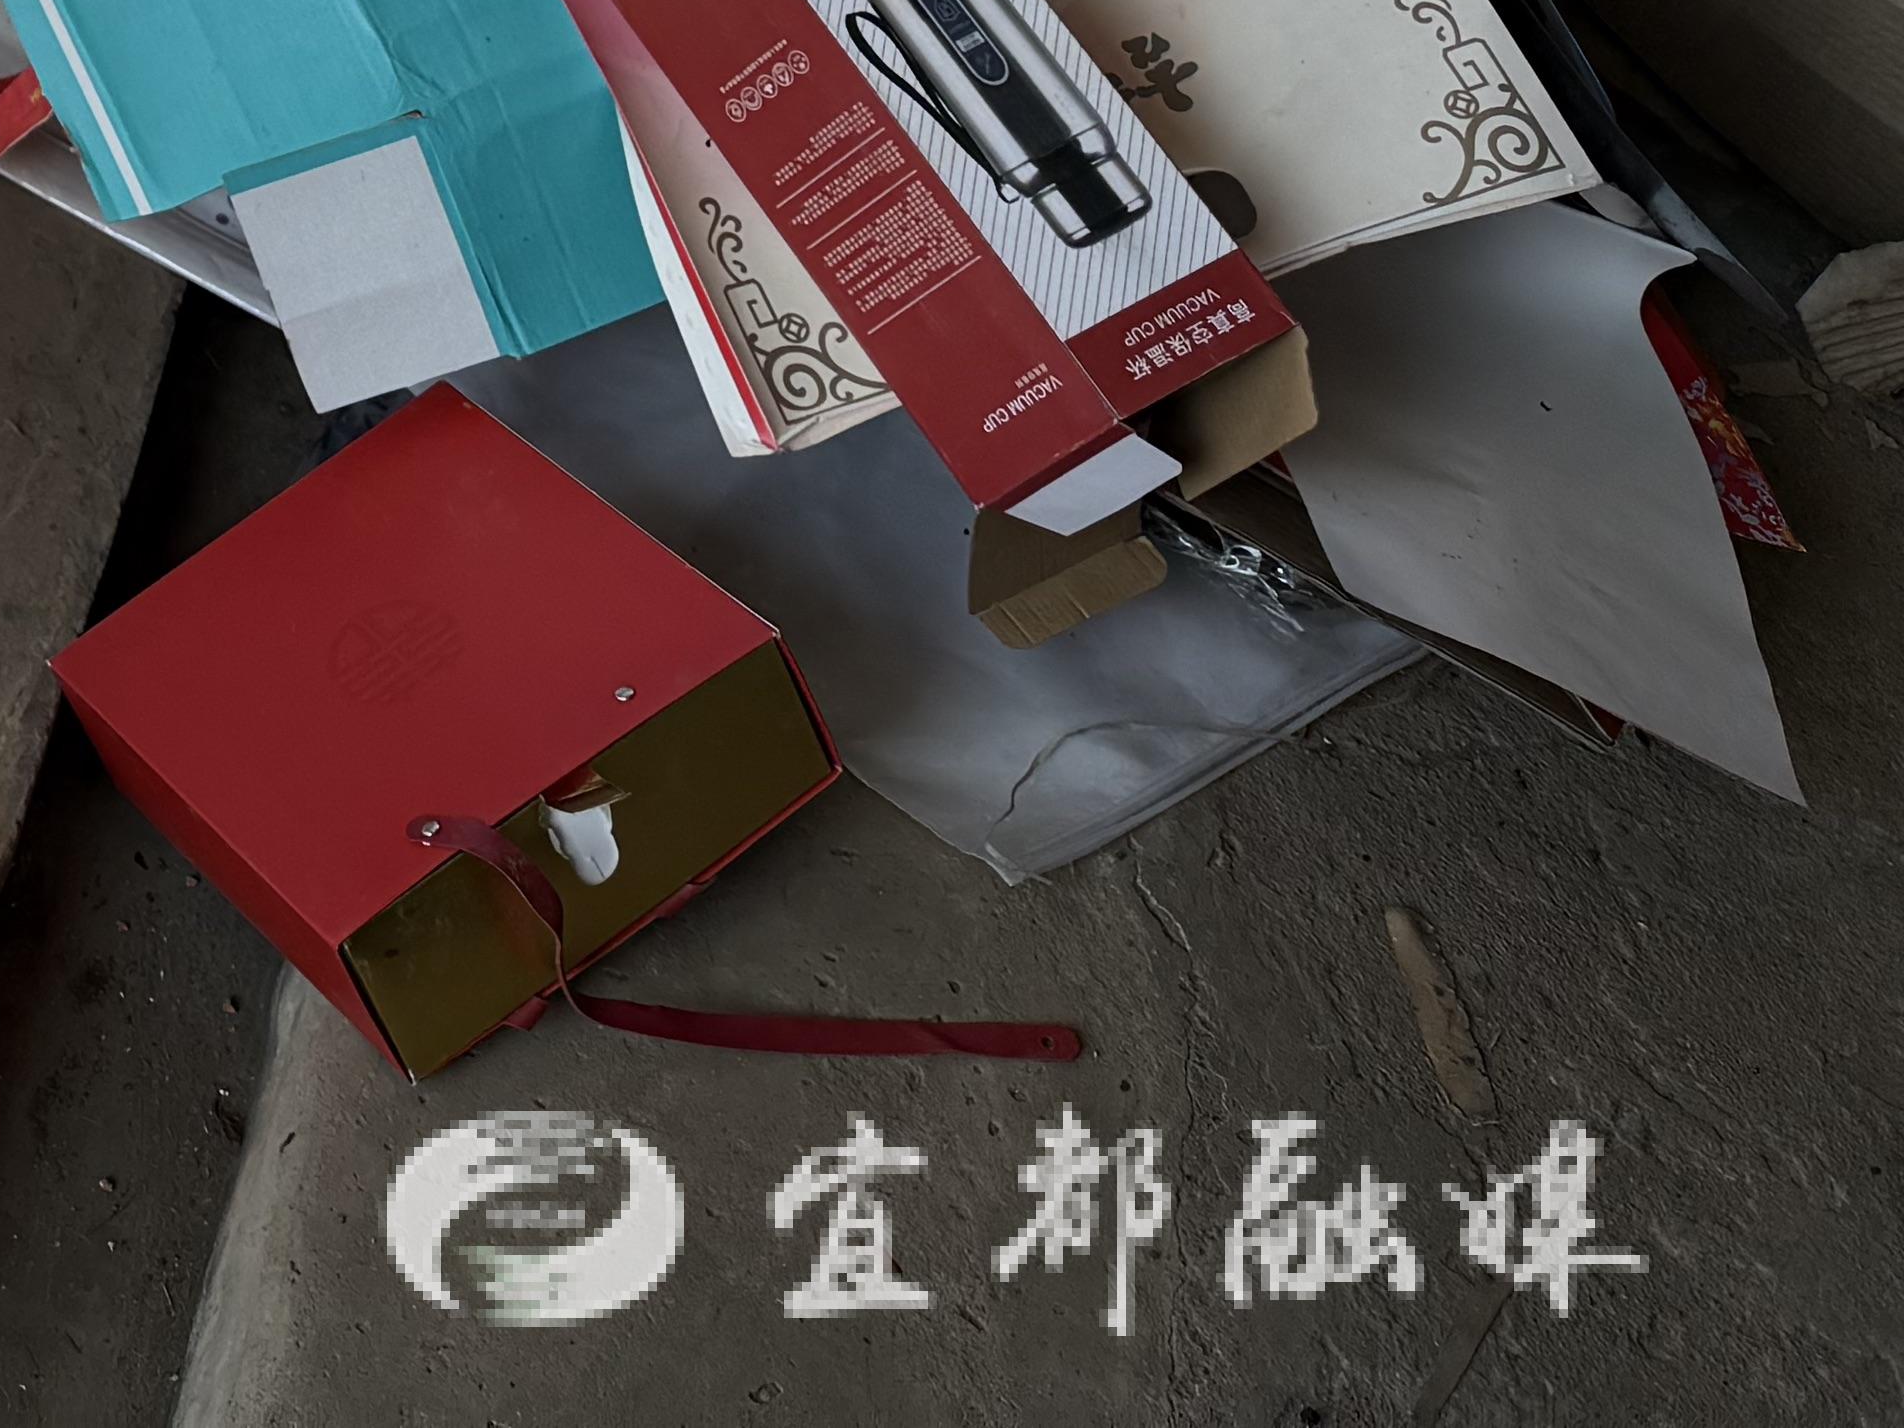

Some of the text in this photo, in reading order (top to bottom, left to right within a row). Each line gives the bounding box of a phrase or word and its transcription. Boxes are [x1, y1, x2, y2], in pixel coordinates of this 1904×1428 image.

[1122, 287, 1220, 350] VACUUM CUP
[1122, 295, 1258, 383] 高真空保温杯
[980, 406, 1010, 435] CUP
[1007, 373, 1063, 417] VACUUM
